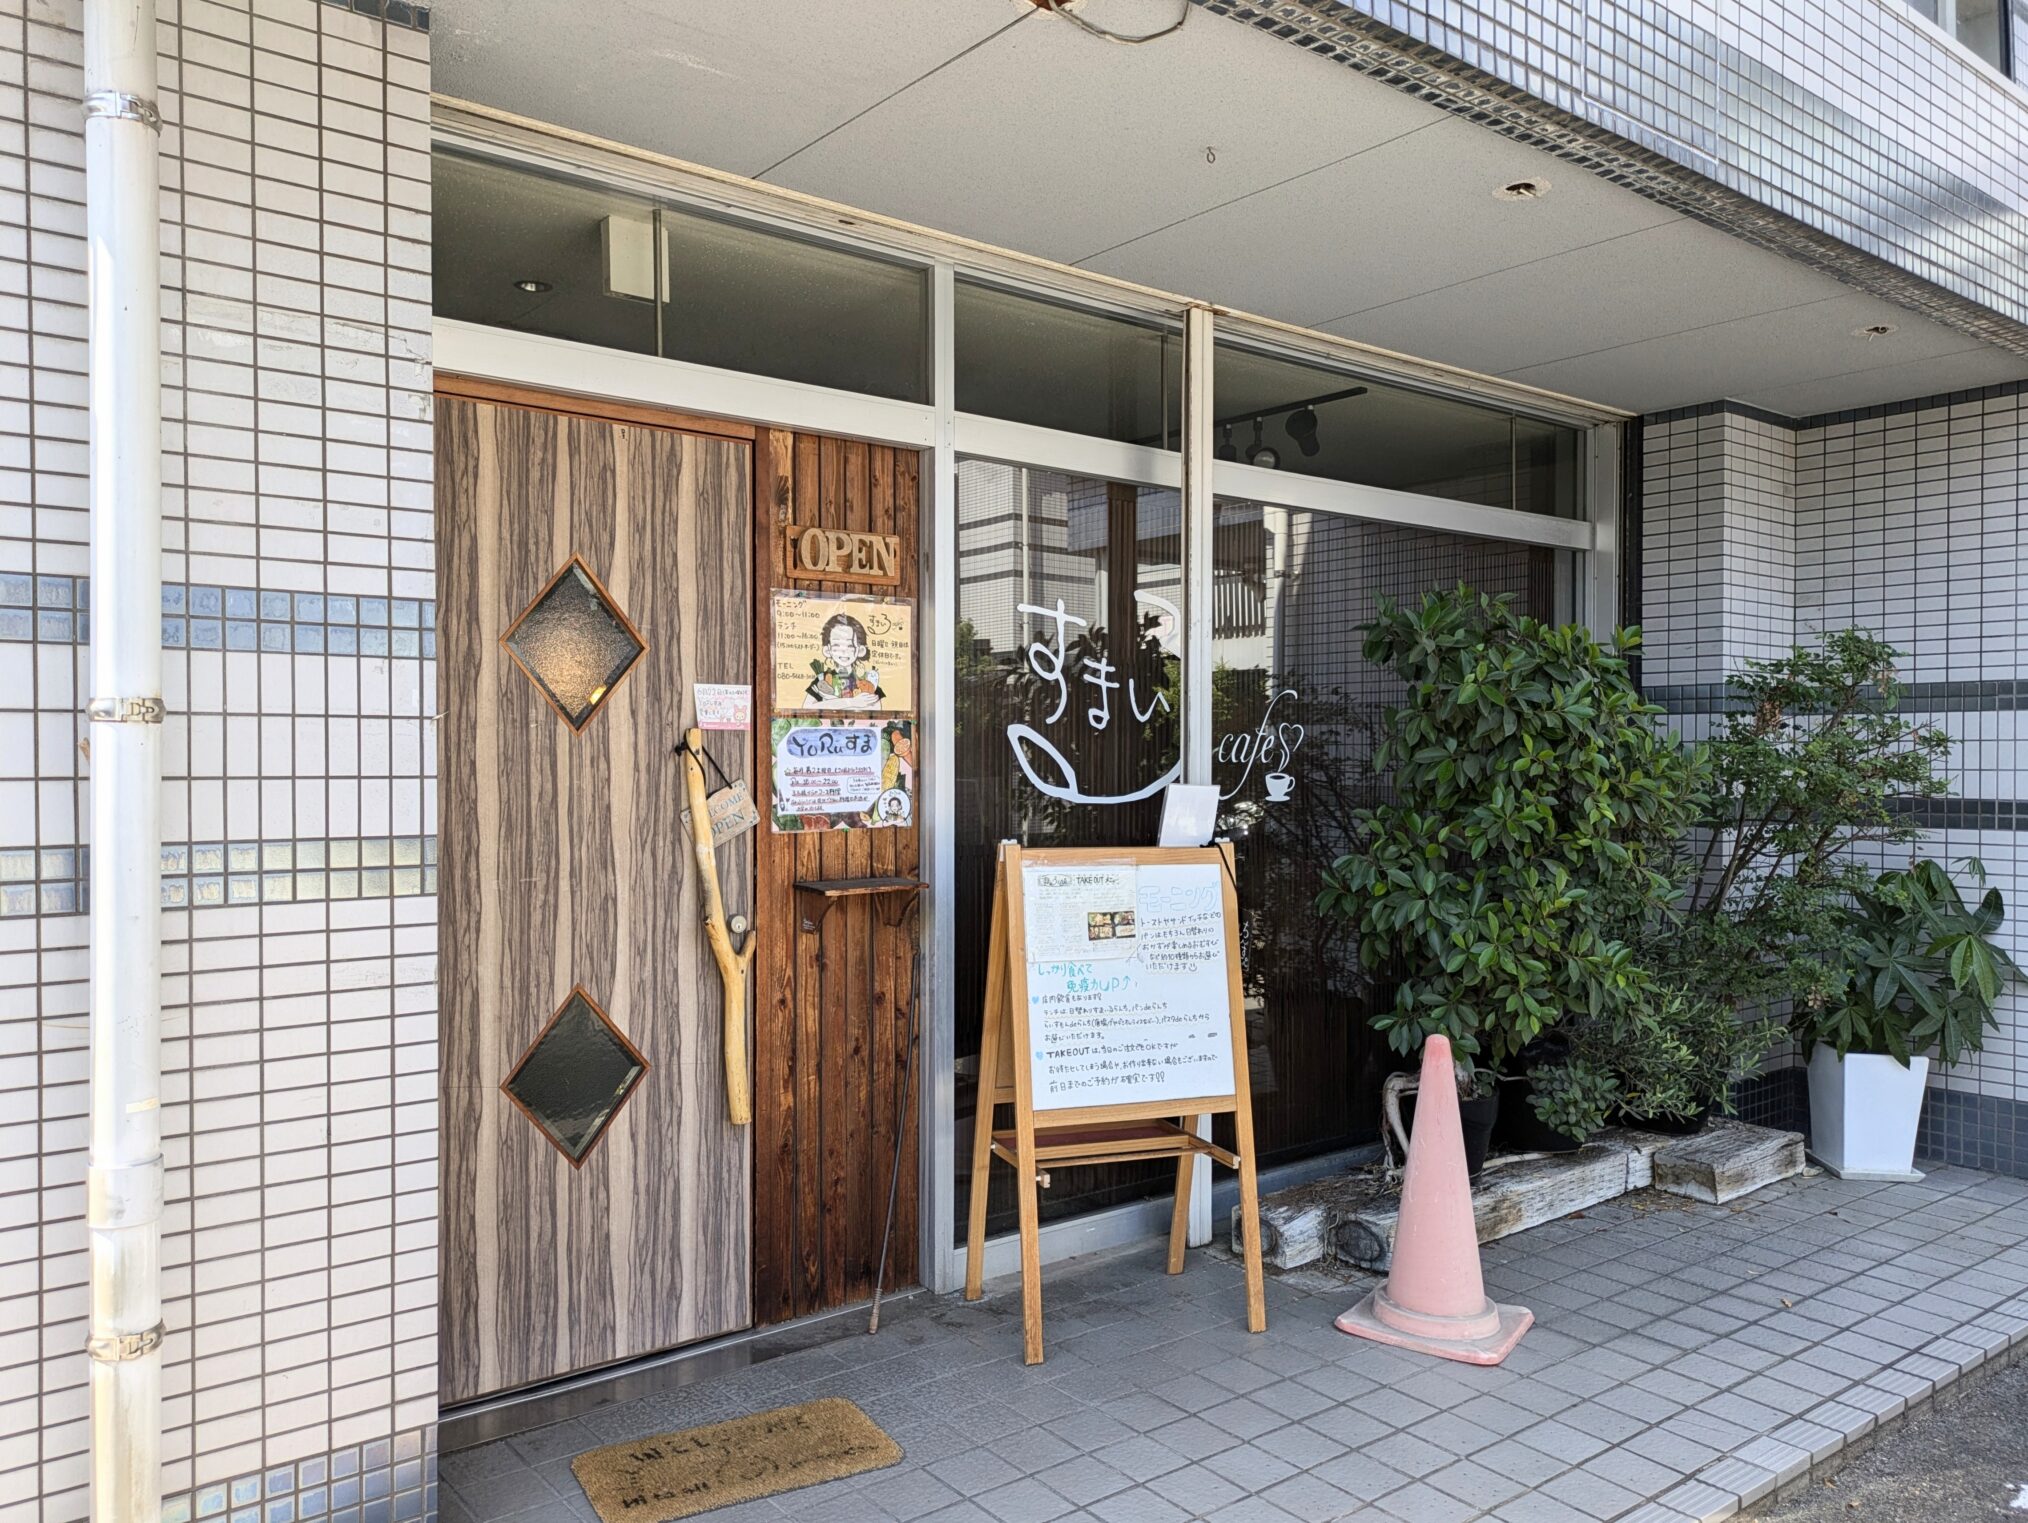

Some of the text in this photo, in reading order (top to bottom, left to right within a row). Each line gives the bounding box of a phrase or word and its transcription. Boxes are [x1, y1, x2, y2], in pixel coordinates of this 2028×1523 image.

[801, 528, 899, 577] OPEN
[776, 599, 807, 608] モーニング
[777, 621, 797, 630] ランチ
[777, 662, 794, 670] TEL
[1218, 690, 1298, 800] cafe
[1138, 880, 1219, 913] モーニング
[1037, 961, 1093, 977] しっかり食べて
[1145, 962, 1188, 971] いただけます
